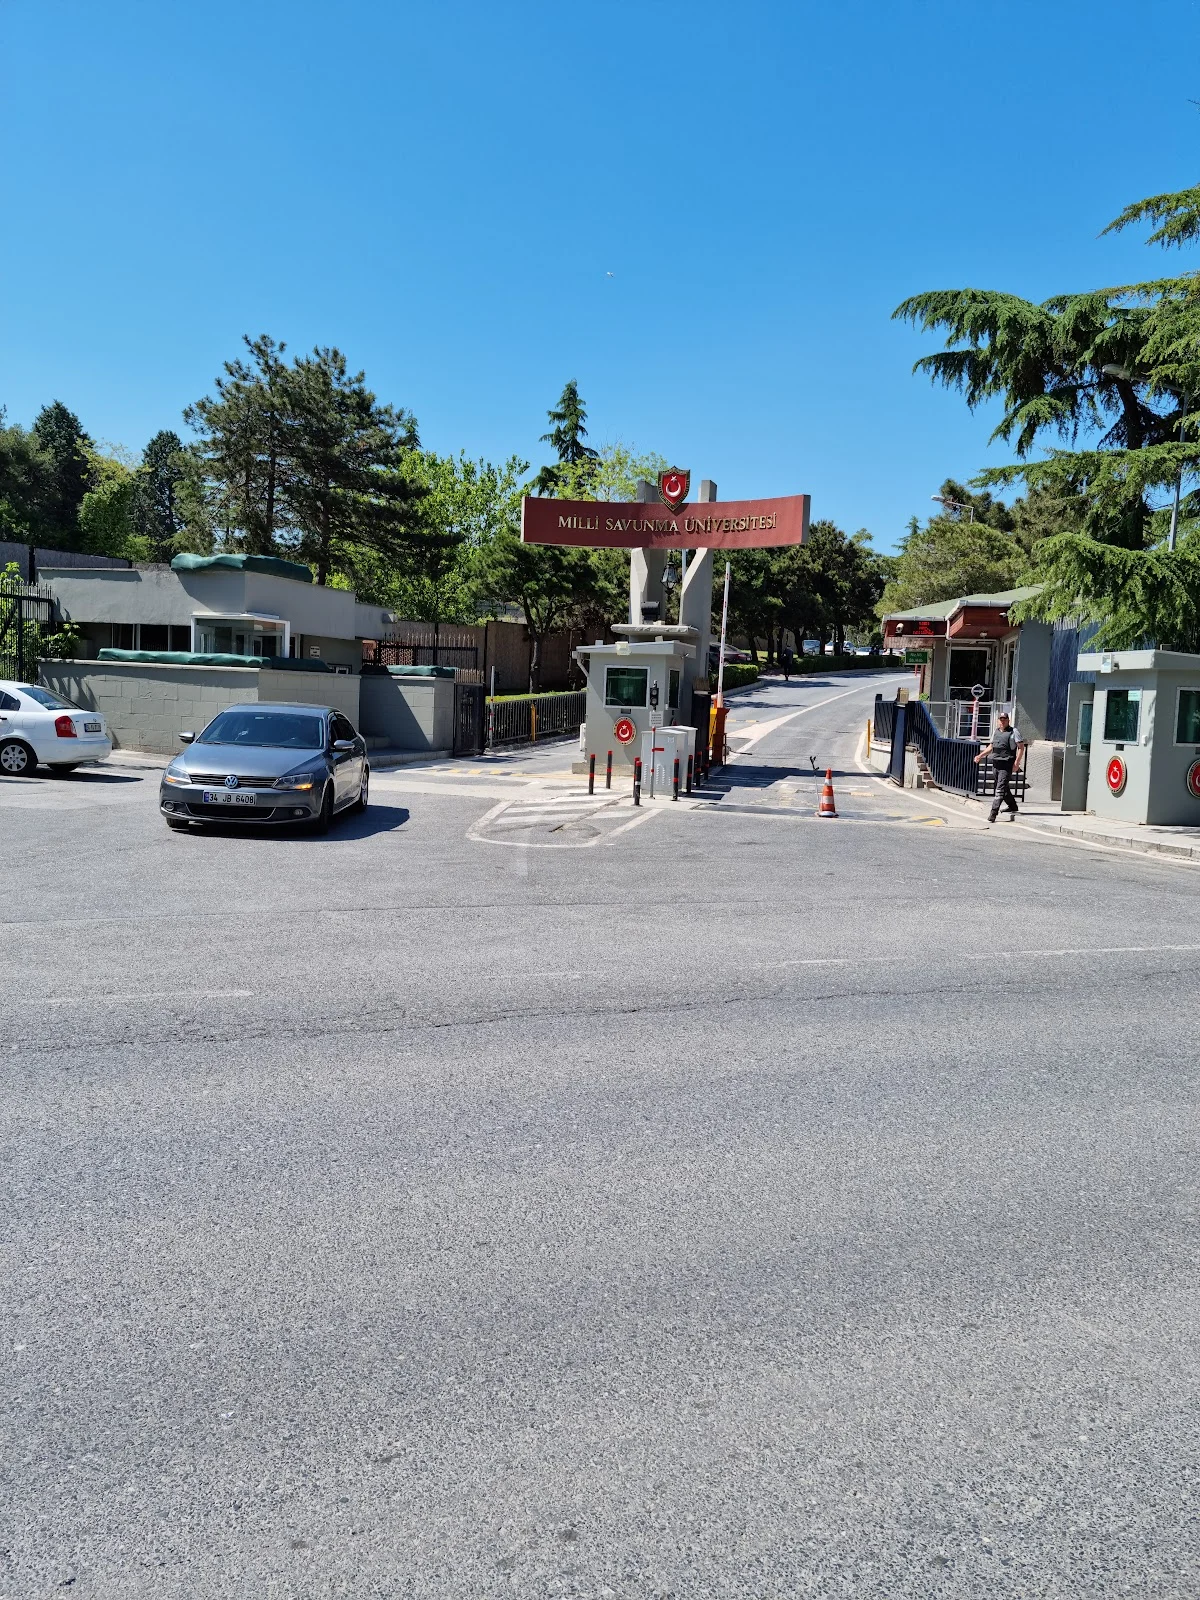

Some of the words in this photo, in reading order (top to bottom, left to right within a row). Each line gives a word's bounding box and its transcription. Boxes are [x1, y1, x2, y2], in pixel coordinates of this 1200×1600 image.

[558, 513, 599, 530] MİLLİ
[605, 518, 680, 532] SAVUNMA
[684, 512, 777, 532] ÜNİVERSİTESİ
[209, 793, 218, 802] 34
[222, 794, 232, 803] JB
[235, 795, 254, 804] 6408
